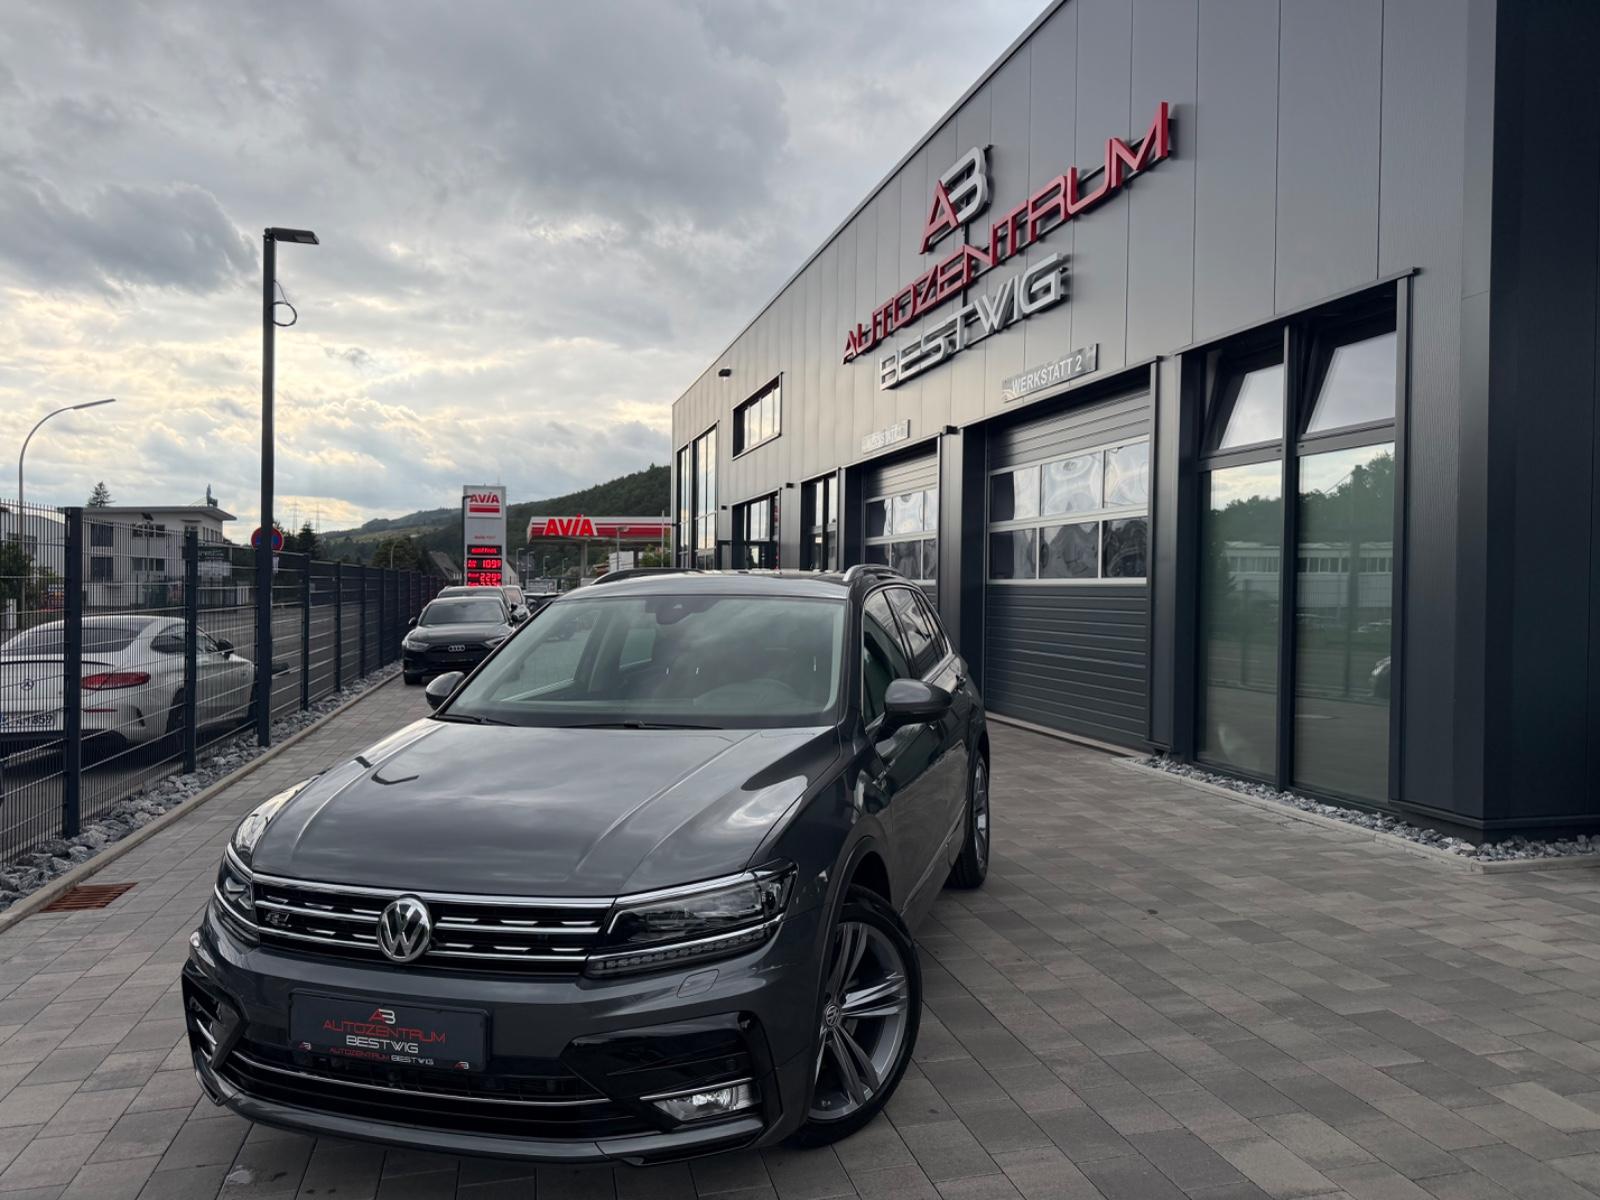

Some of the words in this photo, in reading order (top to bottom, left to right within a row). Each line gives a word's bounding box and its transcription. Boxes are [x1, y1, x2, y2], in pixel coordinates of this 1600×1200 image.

[842, 101, 1169, 365] AUTOZENTRUM
[879, 252, 1064, 391] BESTWIG
[1012, 357, 1073, 393] WERKSTATT
[1075, 355, 1082, 372] 2
[544, 513, 595, 536] AVIA
[323, 1019, 446, 1043] AUTOZENTRUM
[346, 1035, 419, 1054] BESTWIG
[391, 1054, 434, 1065] BESTWIG
